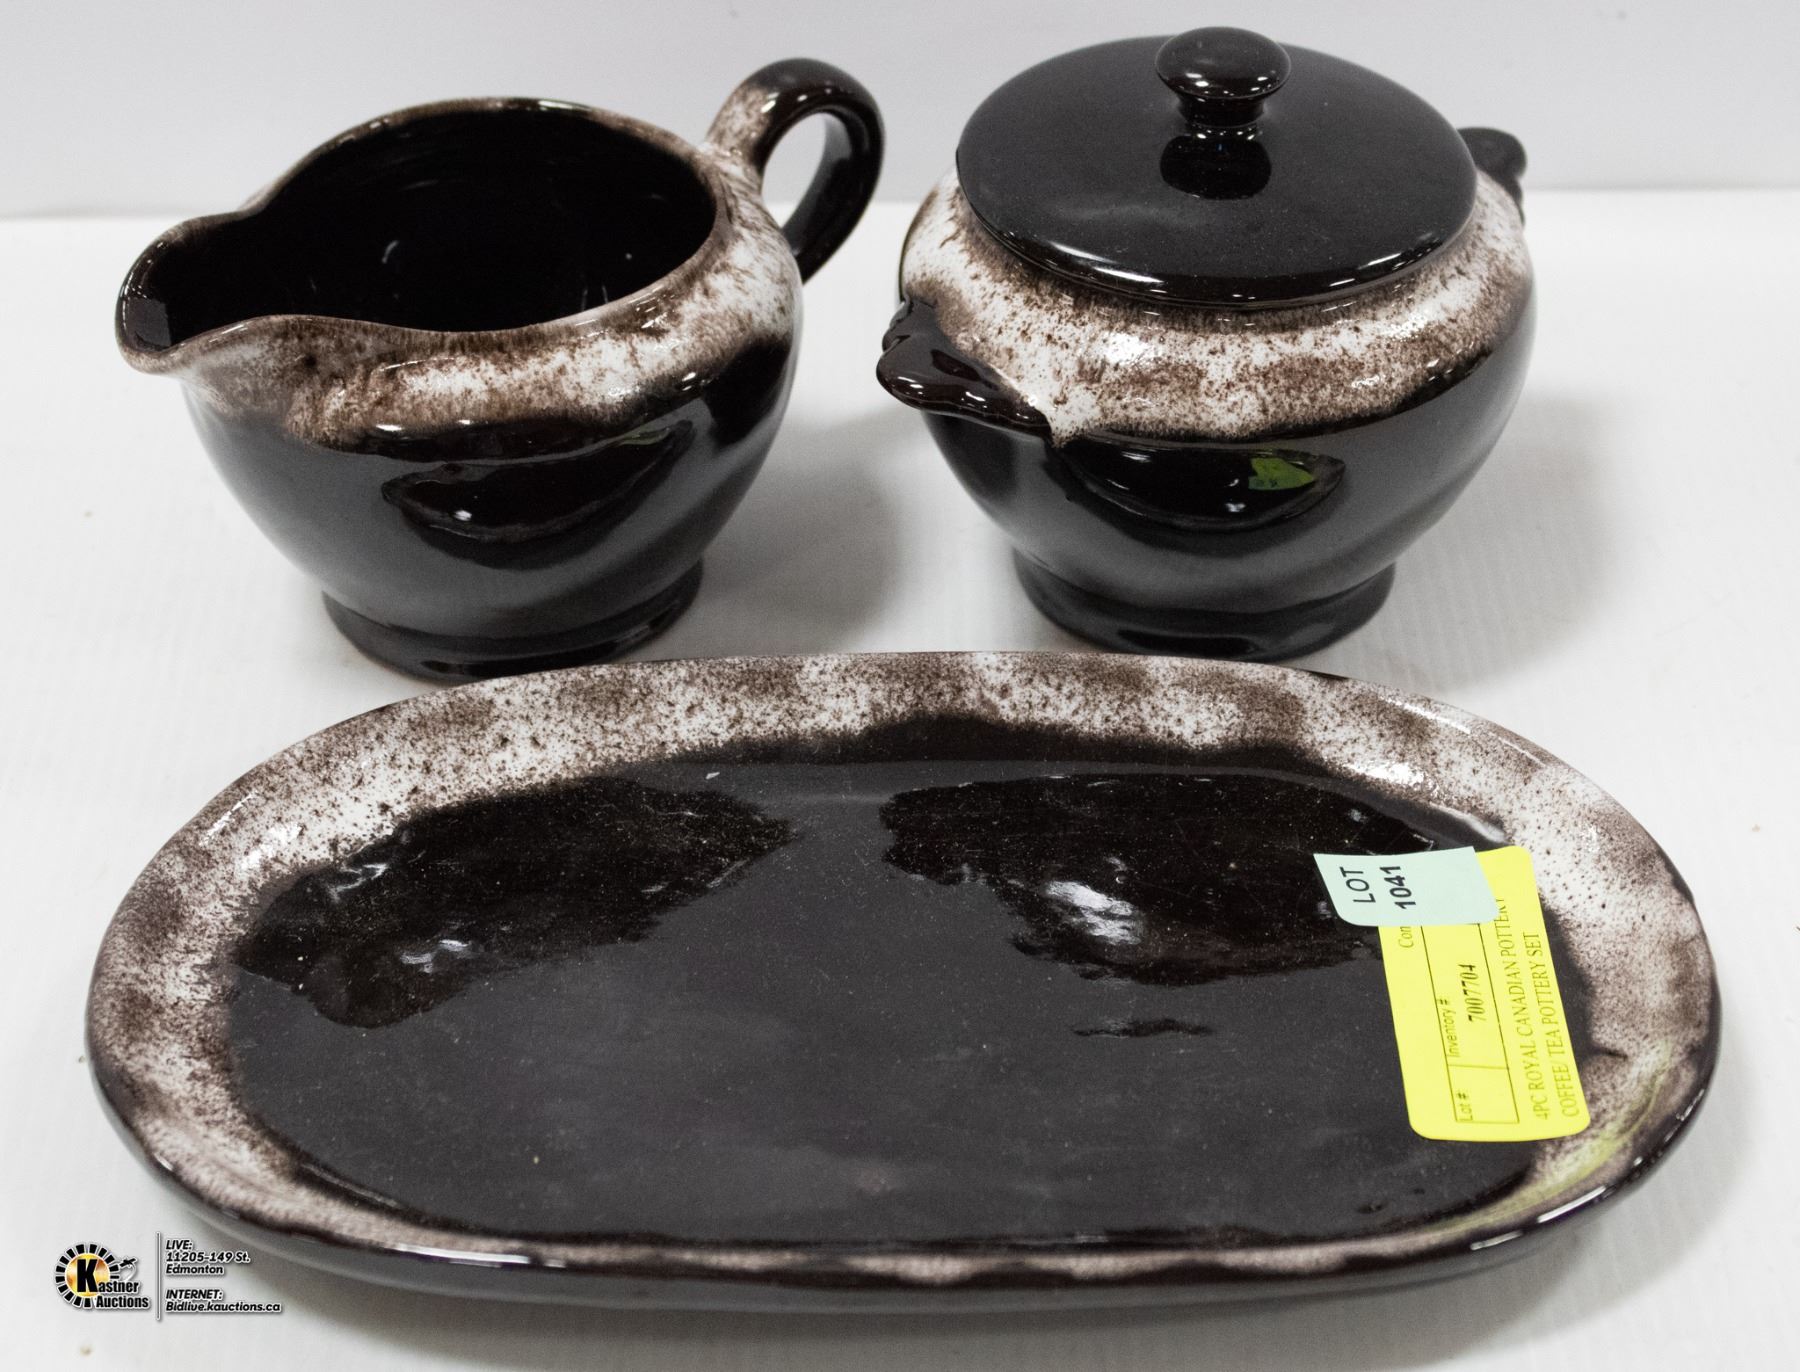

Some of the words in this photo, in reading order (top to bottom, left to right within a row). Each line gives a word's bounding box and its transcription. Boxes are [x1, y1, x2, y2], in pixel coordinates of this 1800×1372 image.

[1340, 866, 1376, 904] LOT
[1380, 865, 1417, 910] 1041
[1398, 924, 1414, 949] Con
[1521, 931, 1543, 958] SET
[1457, 963, 1487, 1023] 7007704
[1502, 960, 1534, 1037] CANADIAN
[1530, 961, 1558, 1026] POTTERY
[1441, 1008, 1461, 1058] Inventory
[1544, 1028, 1566, 1056] TEA
[1519, 1040, 1545, 1090] ROYAL
[1456, 1104, 1474, 1122] Lot
[1529, 1093, 1550, 1121] 4PC
